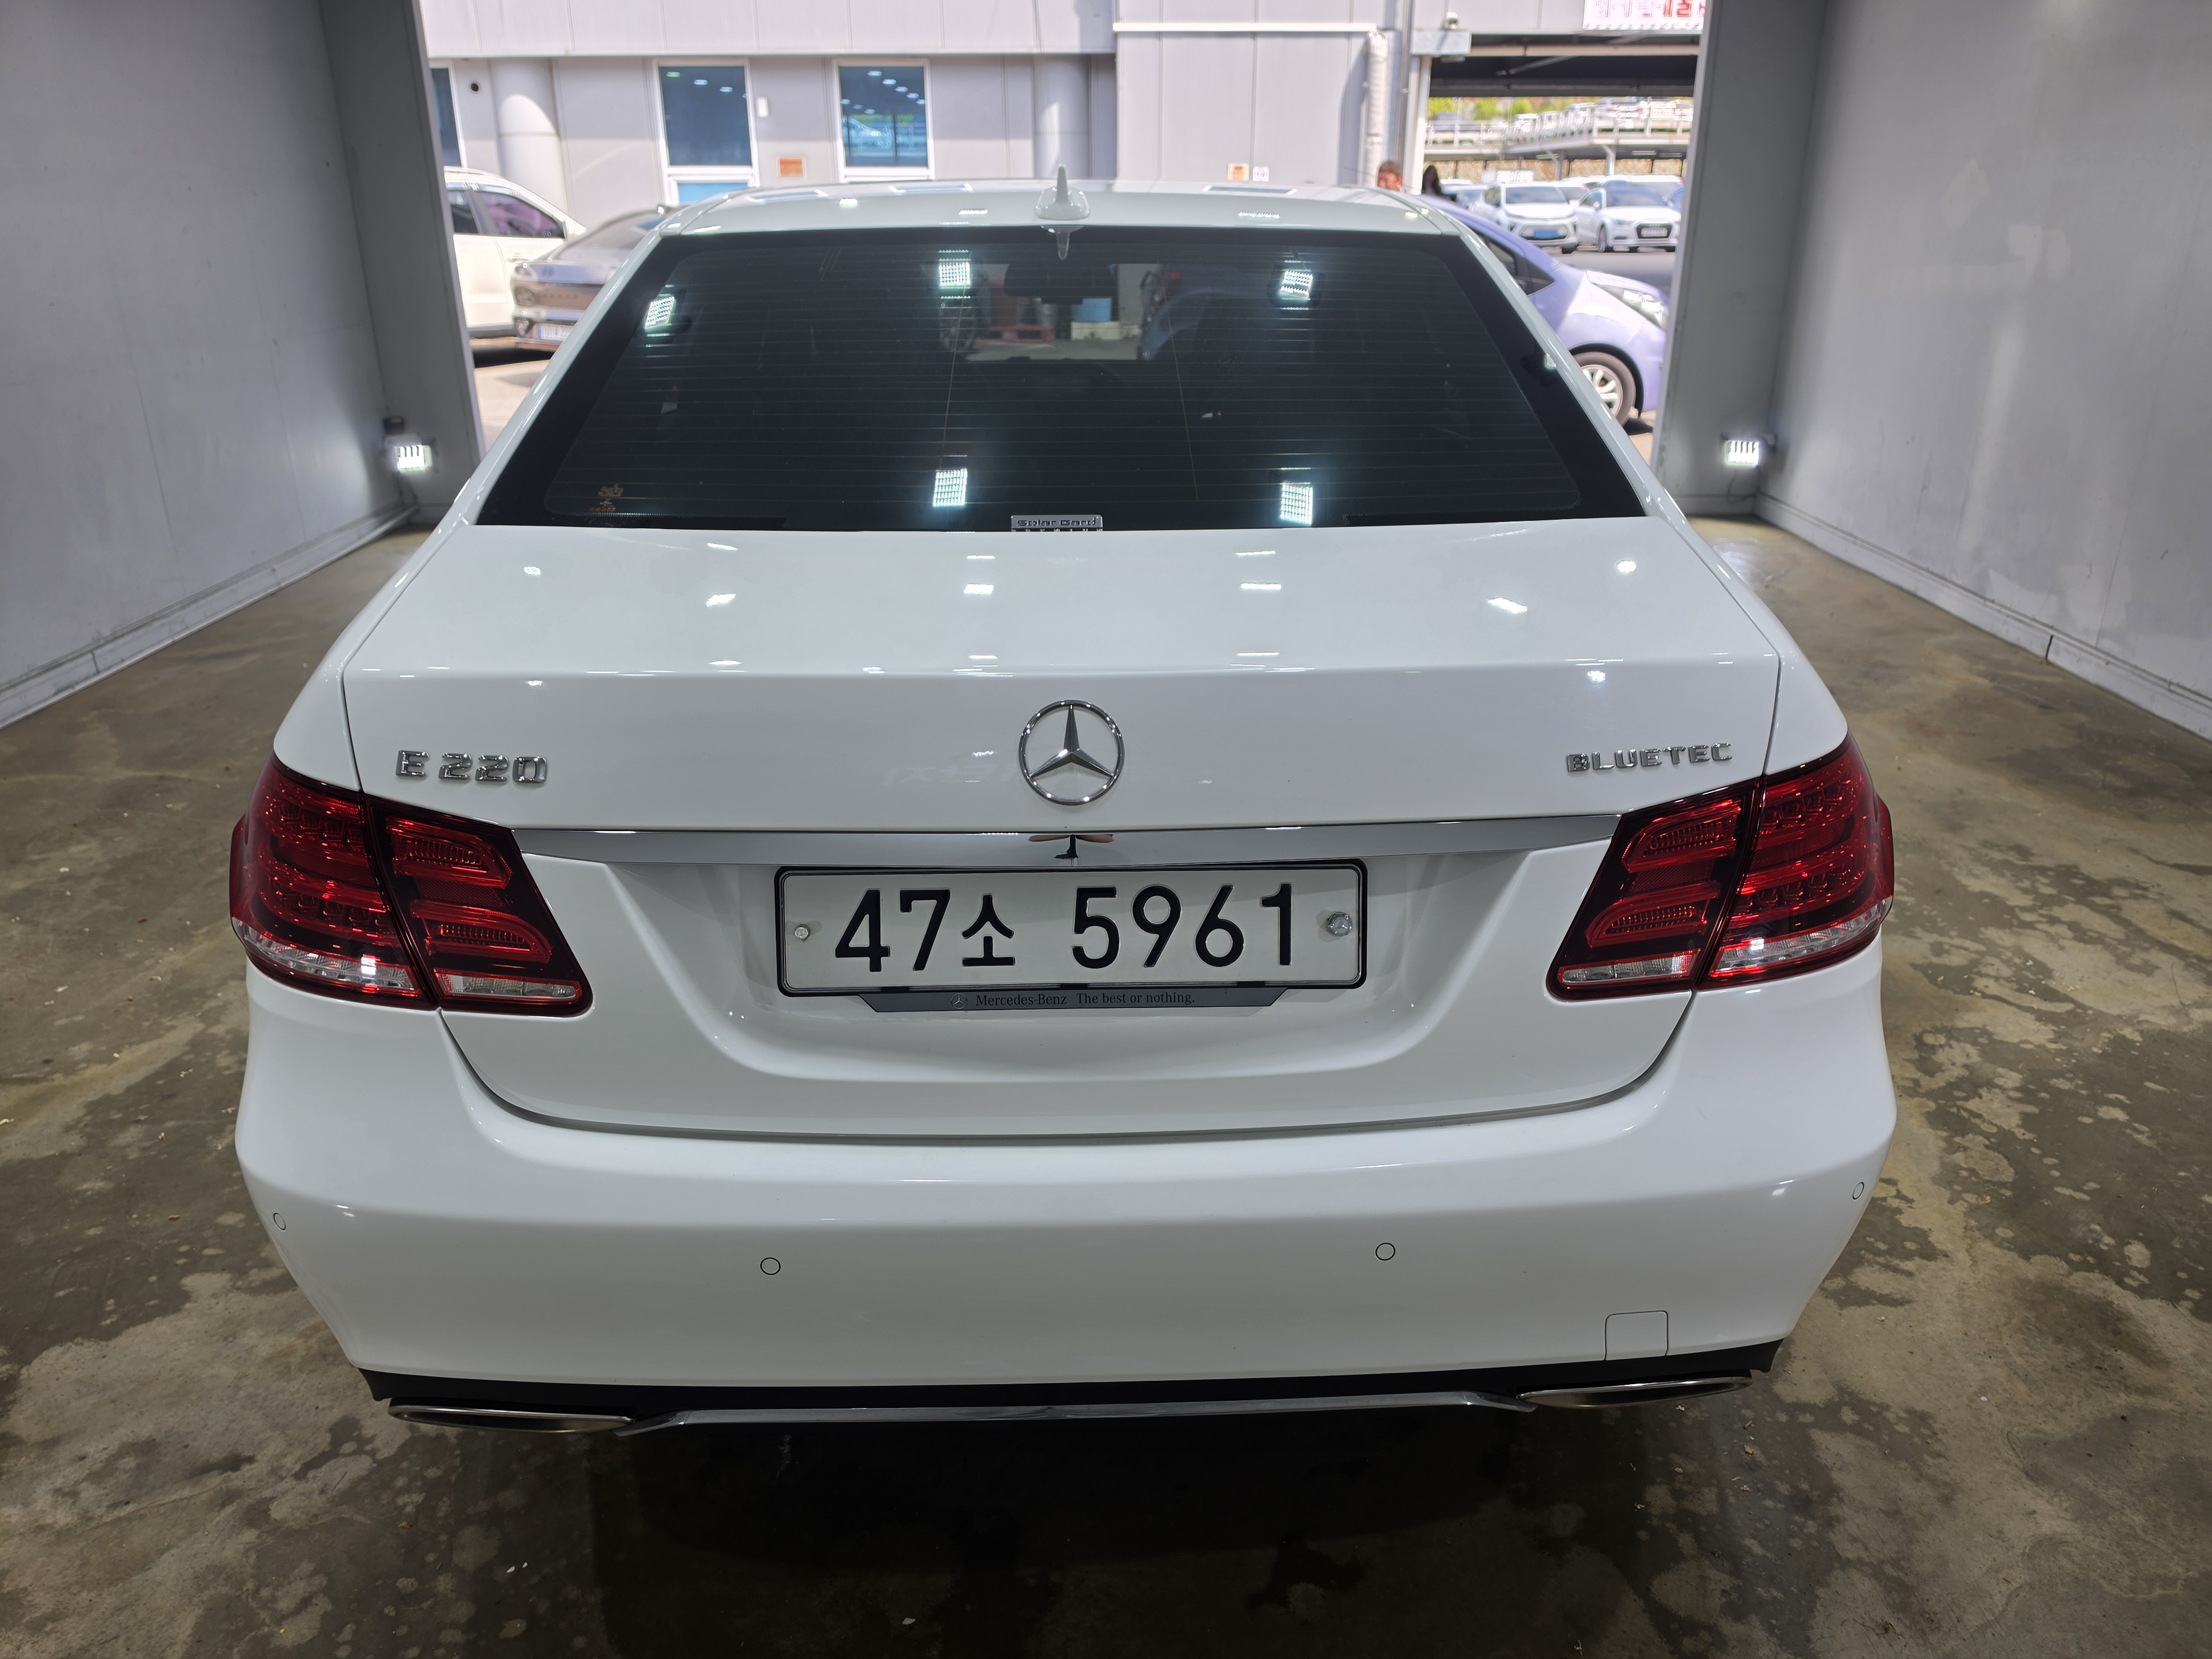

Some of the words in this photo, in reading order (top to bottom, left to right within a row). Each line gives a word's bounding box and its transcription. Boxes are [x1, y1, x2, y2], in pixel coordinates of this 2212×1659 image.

[1060, 517, 1096, 526] Gard
[395, 750, 429, 776] E
[439, 753, 548, 784] 220
[1567, 743, 1733, 772] BLUETEC
[835, 888, 1016, 972] 47소
[1072, 883, 1292, 969] 5961
[975, 994, 1067, 1006] Mercedes-Benz
[1076, 993, 1098, 1004] The
[1102, 993, 1126, 1004] best
[1146, 992, 1195, 1005] nothing.
